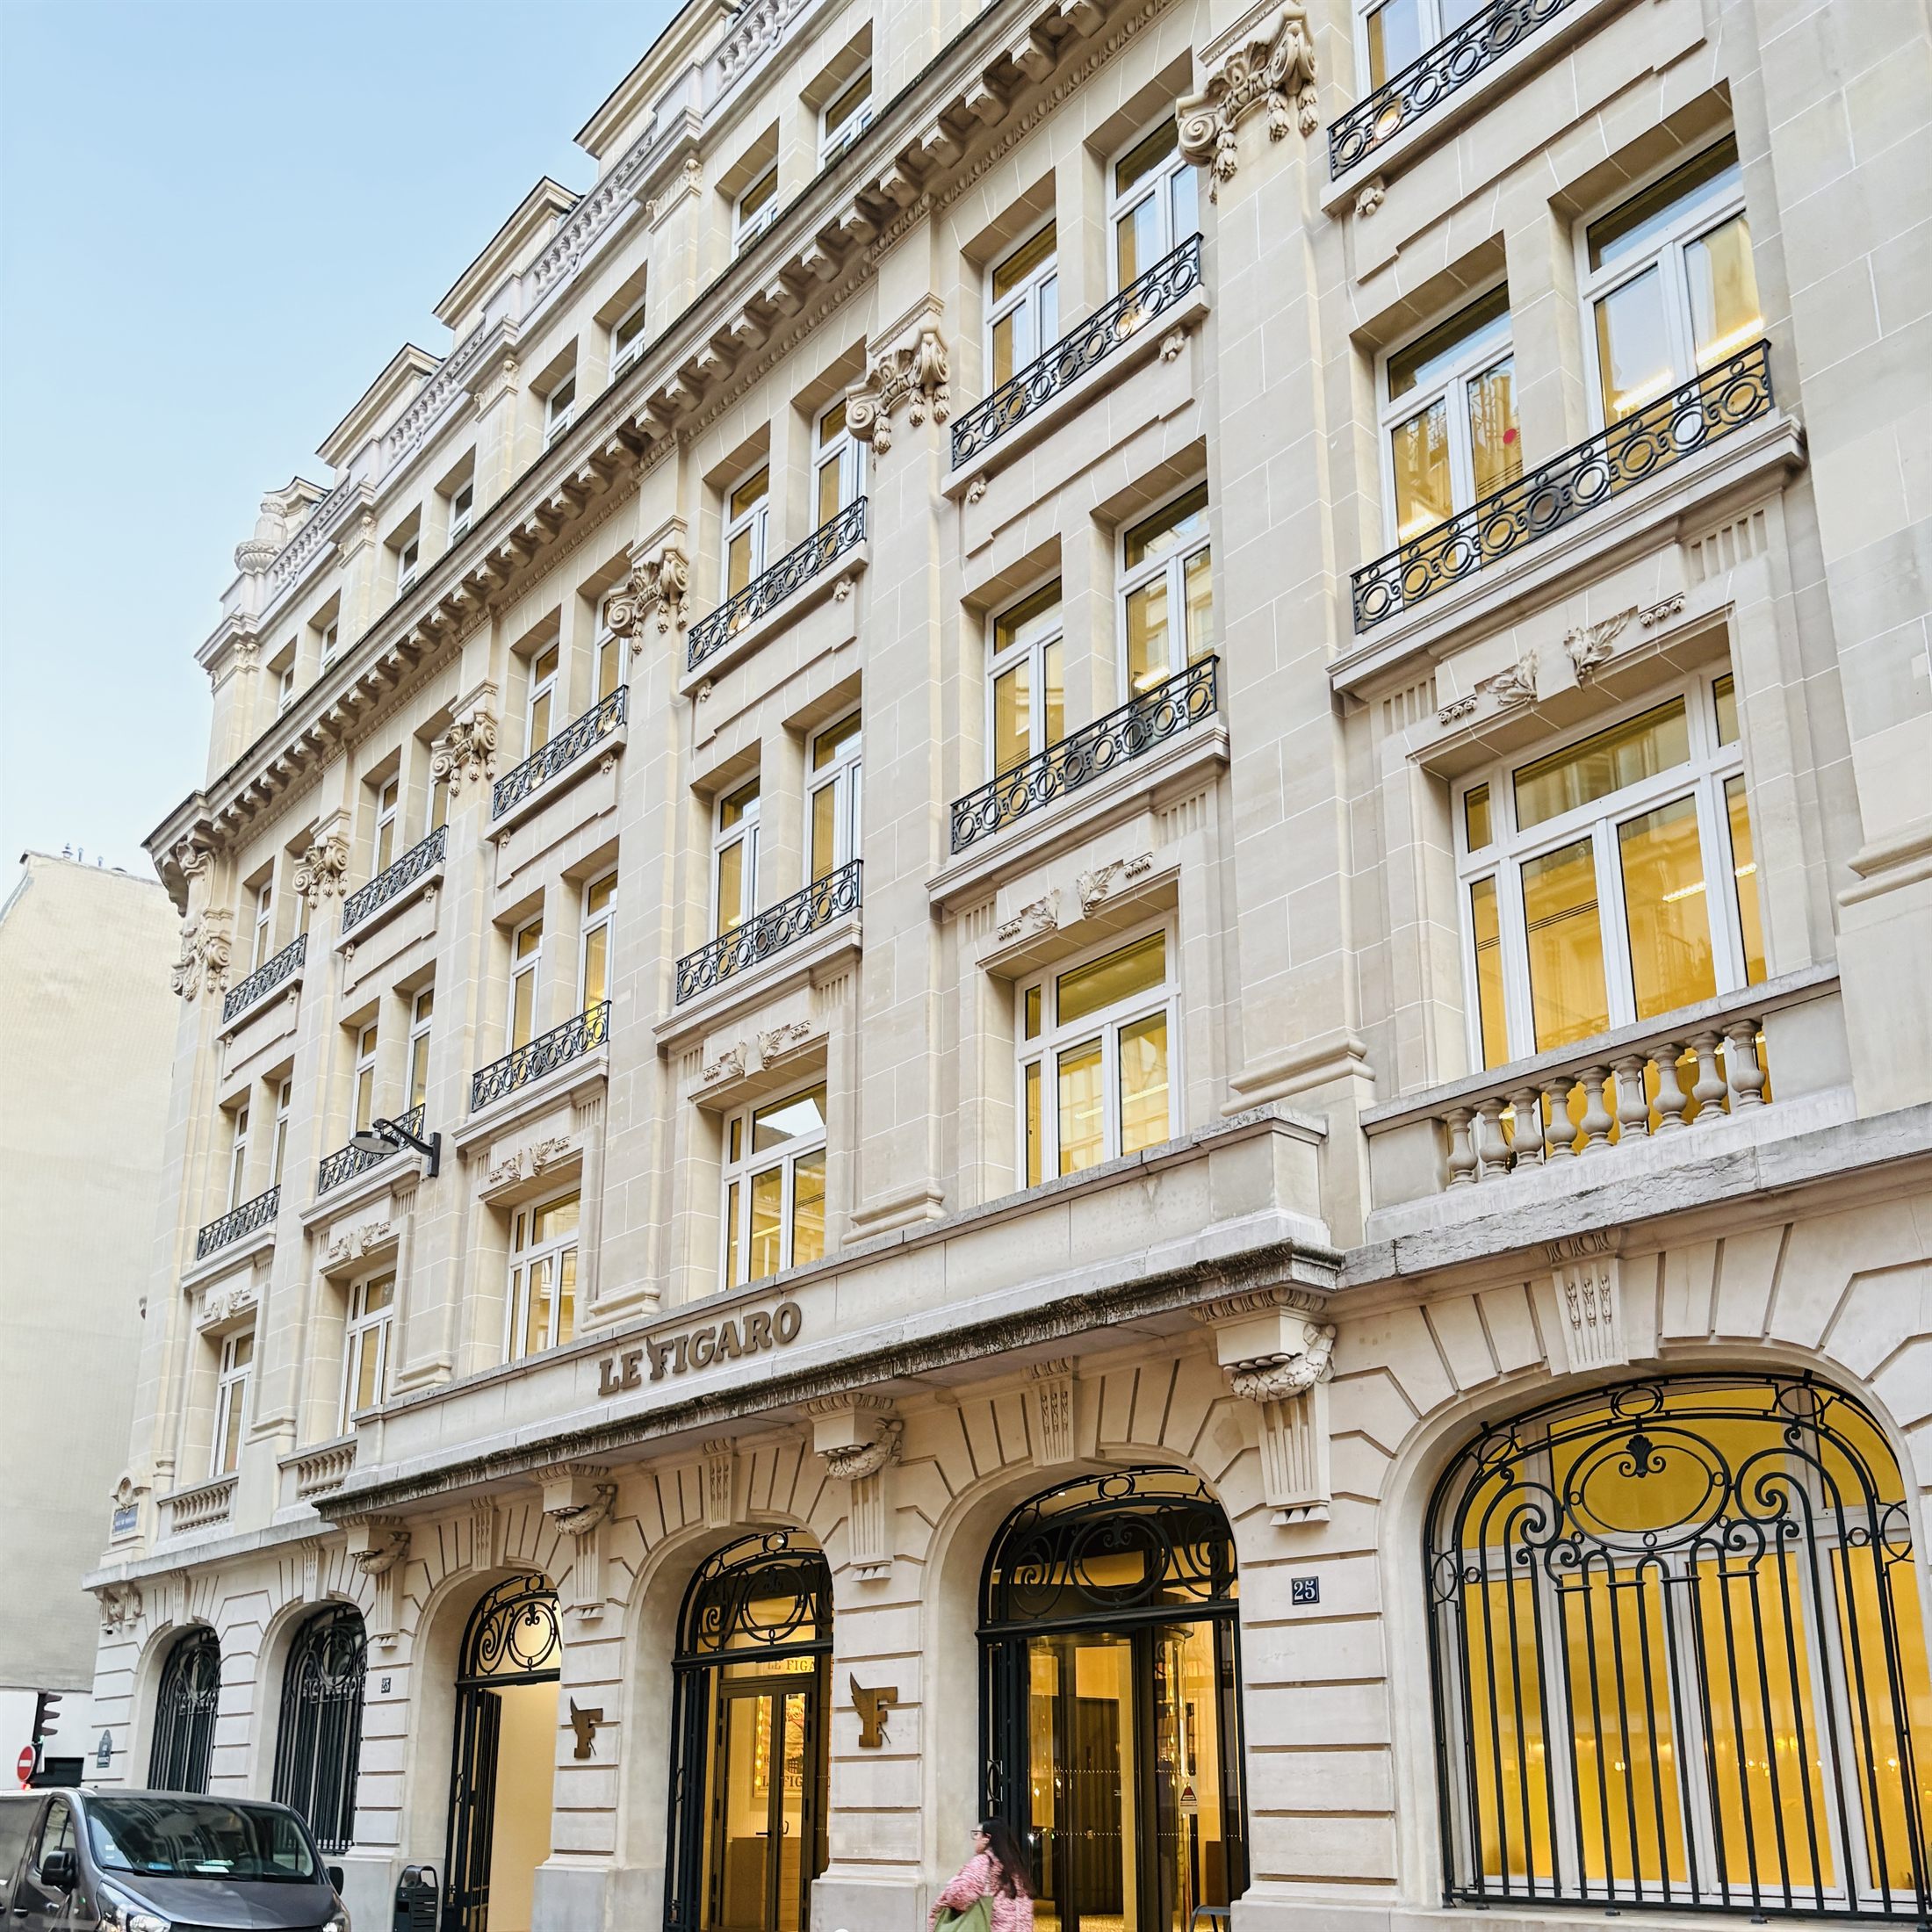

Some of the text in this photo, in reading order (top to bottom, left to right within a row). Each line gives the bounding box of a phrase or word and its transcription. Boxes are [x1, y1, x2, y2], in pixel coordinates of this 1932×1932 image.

[598, 1301, 803, 1395] LE FIGARO
[1294, 1580, 1316, 1600] 25
